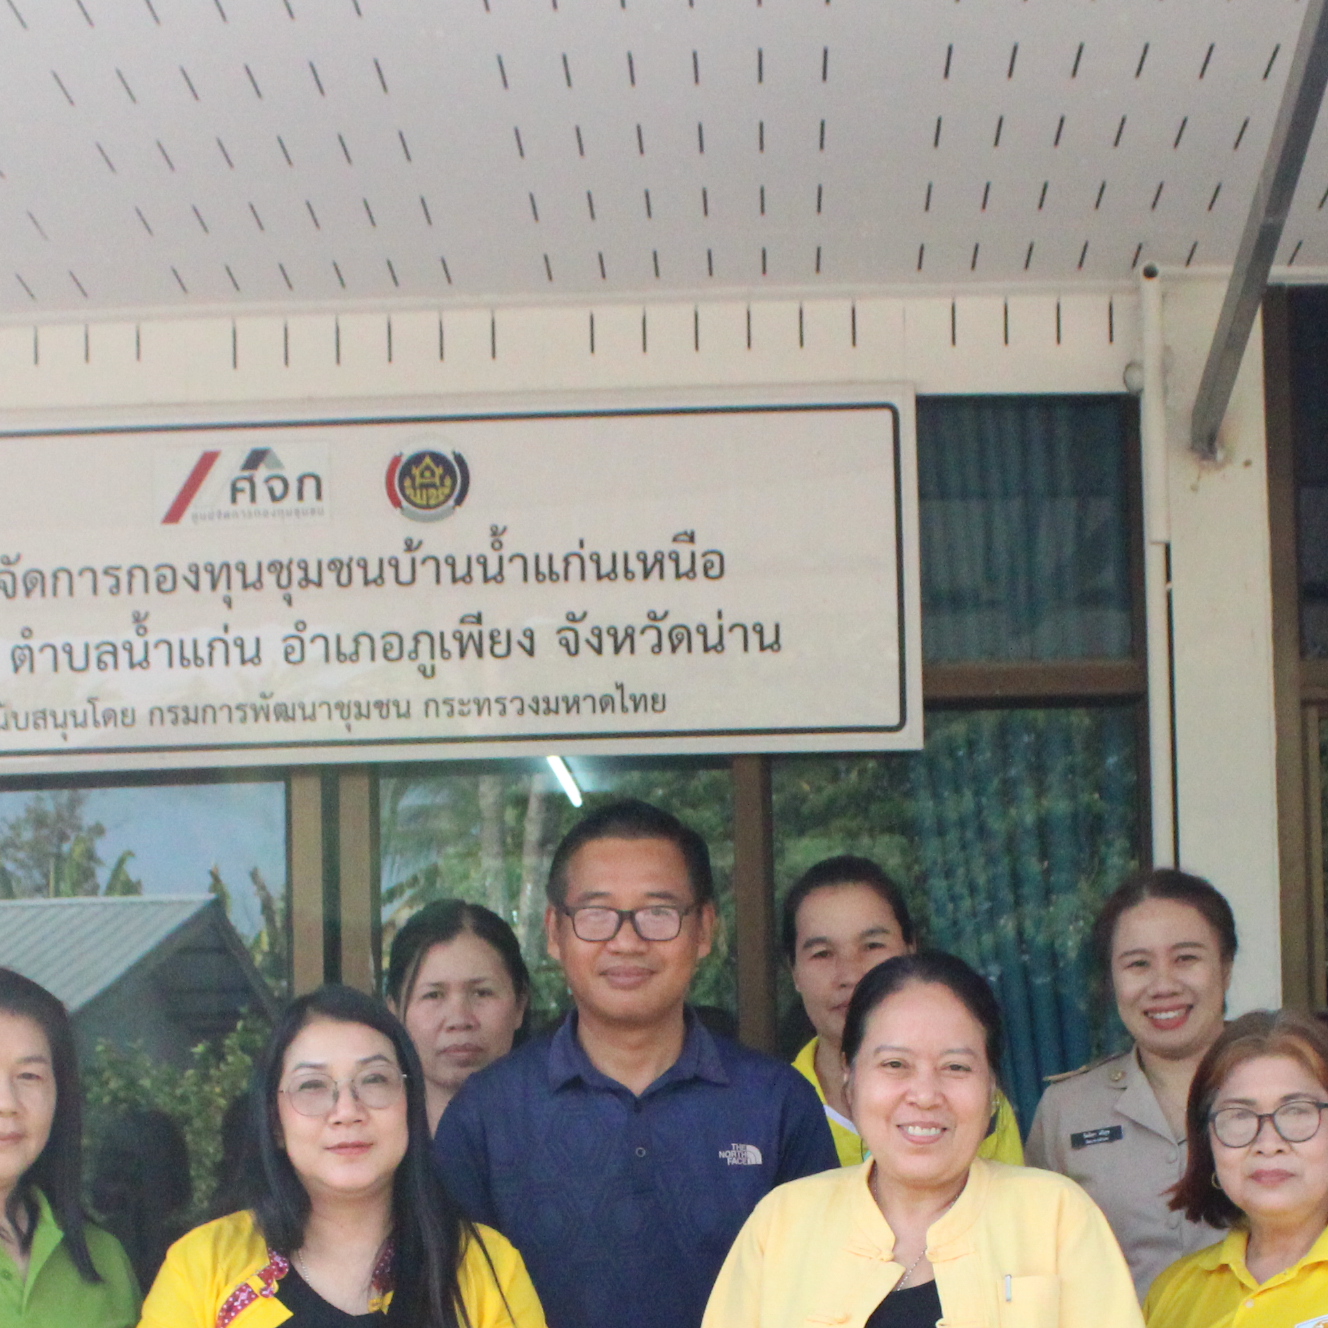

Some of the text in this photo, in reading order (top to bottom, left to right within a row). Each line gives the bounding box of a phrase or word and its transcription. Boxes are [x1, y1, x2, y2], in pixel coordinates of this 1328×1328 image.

[10, 610, 263, 675] ตำบลน้ำแก่น
[282, 611, 537, 680] อำเภอภูเพียง
[556, 609, 783, 660] จังหวัดน่าน
[148, 691, 411, 734] กรมการพัฒนาชุมชน
[423, 681, 668, 720] กระทรวงมหาดไทย
[731, 1143, 747, 1151] THE
[718, 1150, 747, 1159] NORTH
[727, 1157, 749, 1166] FACE
